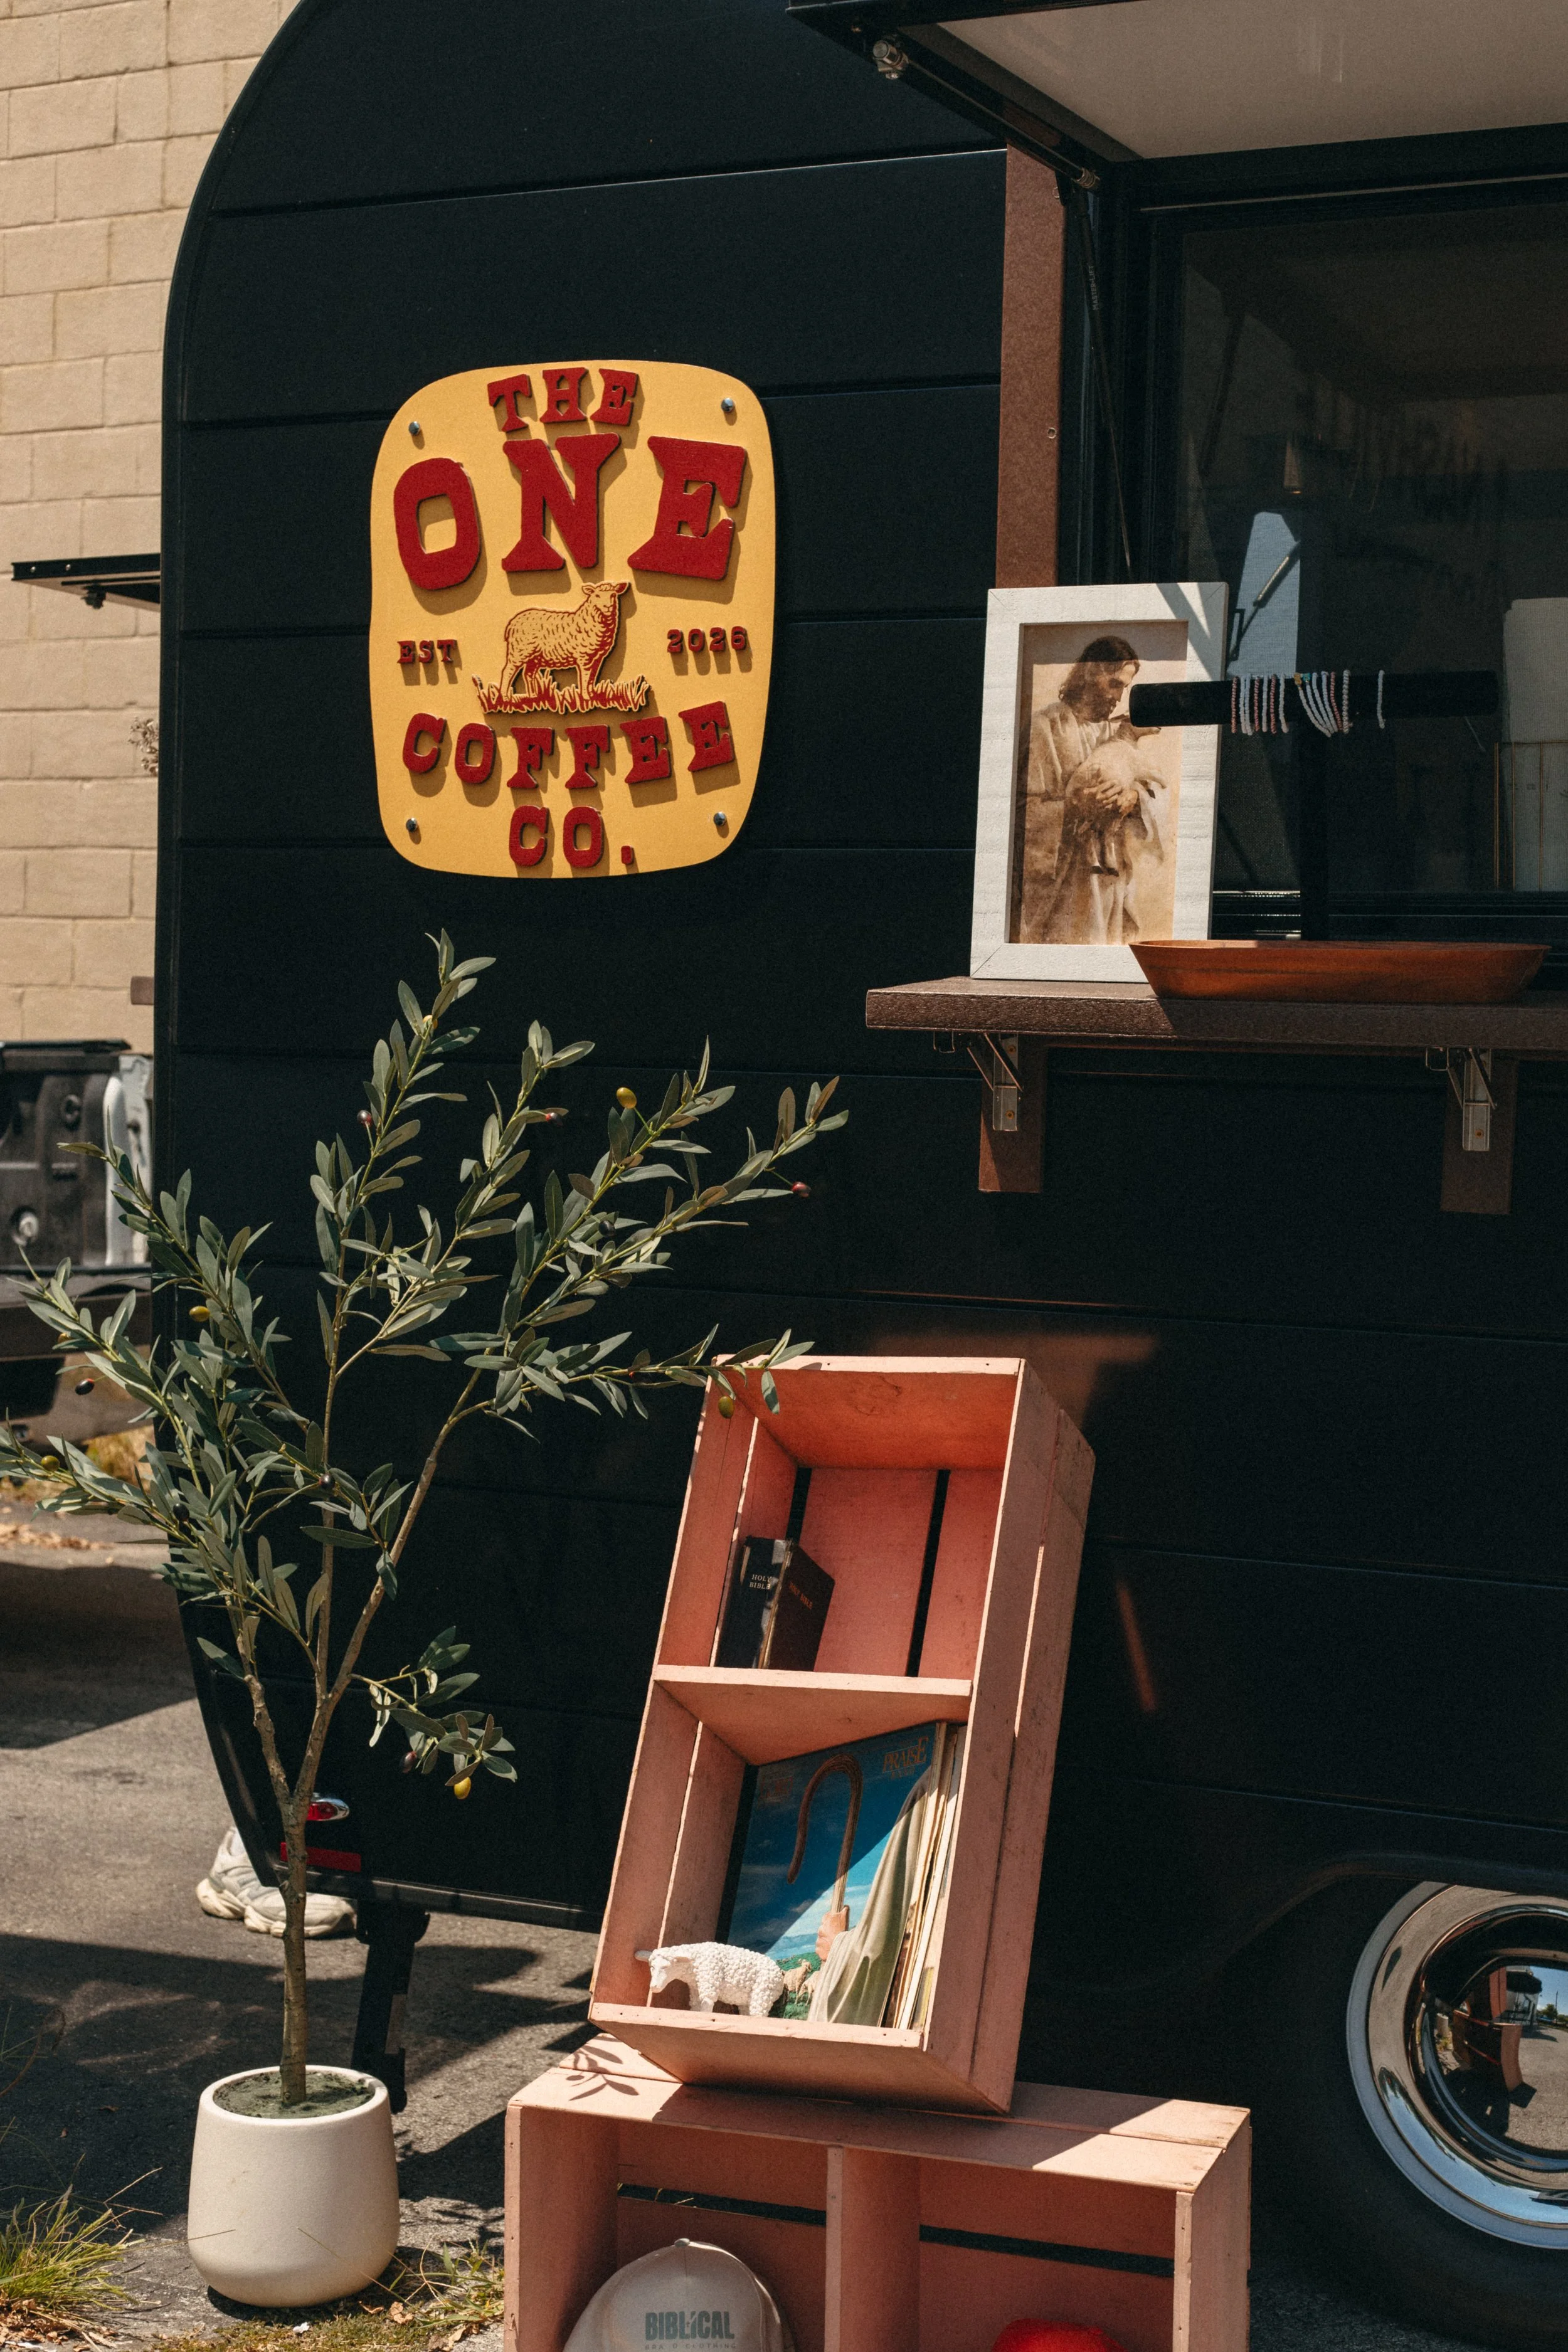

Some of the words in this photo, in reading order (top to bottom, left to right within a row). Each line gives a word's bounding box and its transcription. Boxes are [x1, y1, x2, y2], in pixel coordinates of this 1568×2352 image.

[488, 368, 638, 432] THE
[394, 433, 746, 590] ONE
[397, 639, 457, 663] EST
[667, 626, 746, 652] 2026
[403, 701, 735, 789] COFFEE
[509, 806, 635, 868] CO.
[750, 1582, 771, 1590] BIBLE
[751, 1574, 772, 1582] HOLY
[645, 2311, 735, 2340] BIBLICAL
